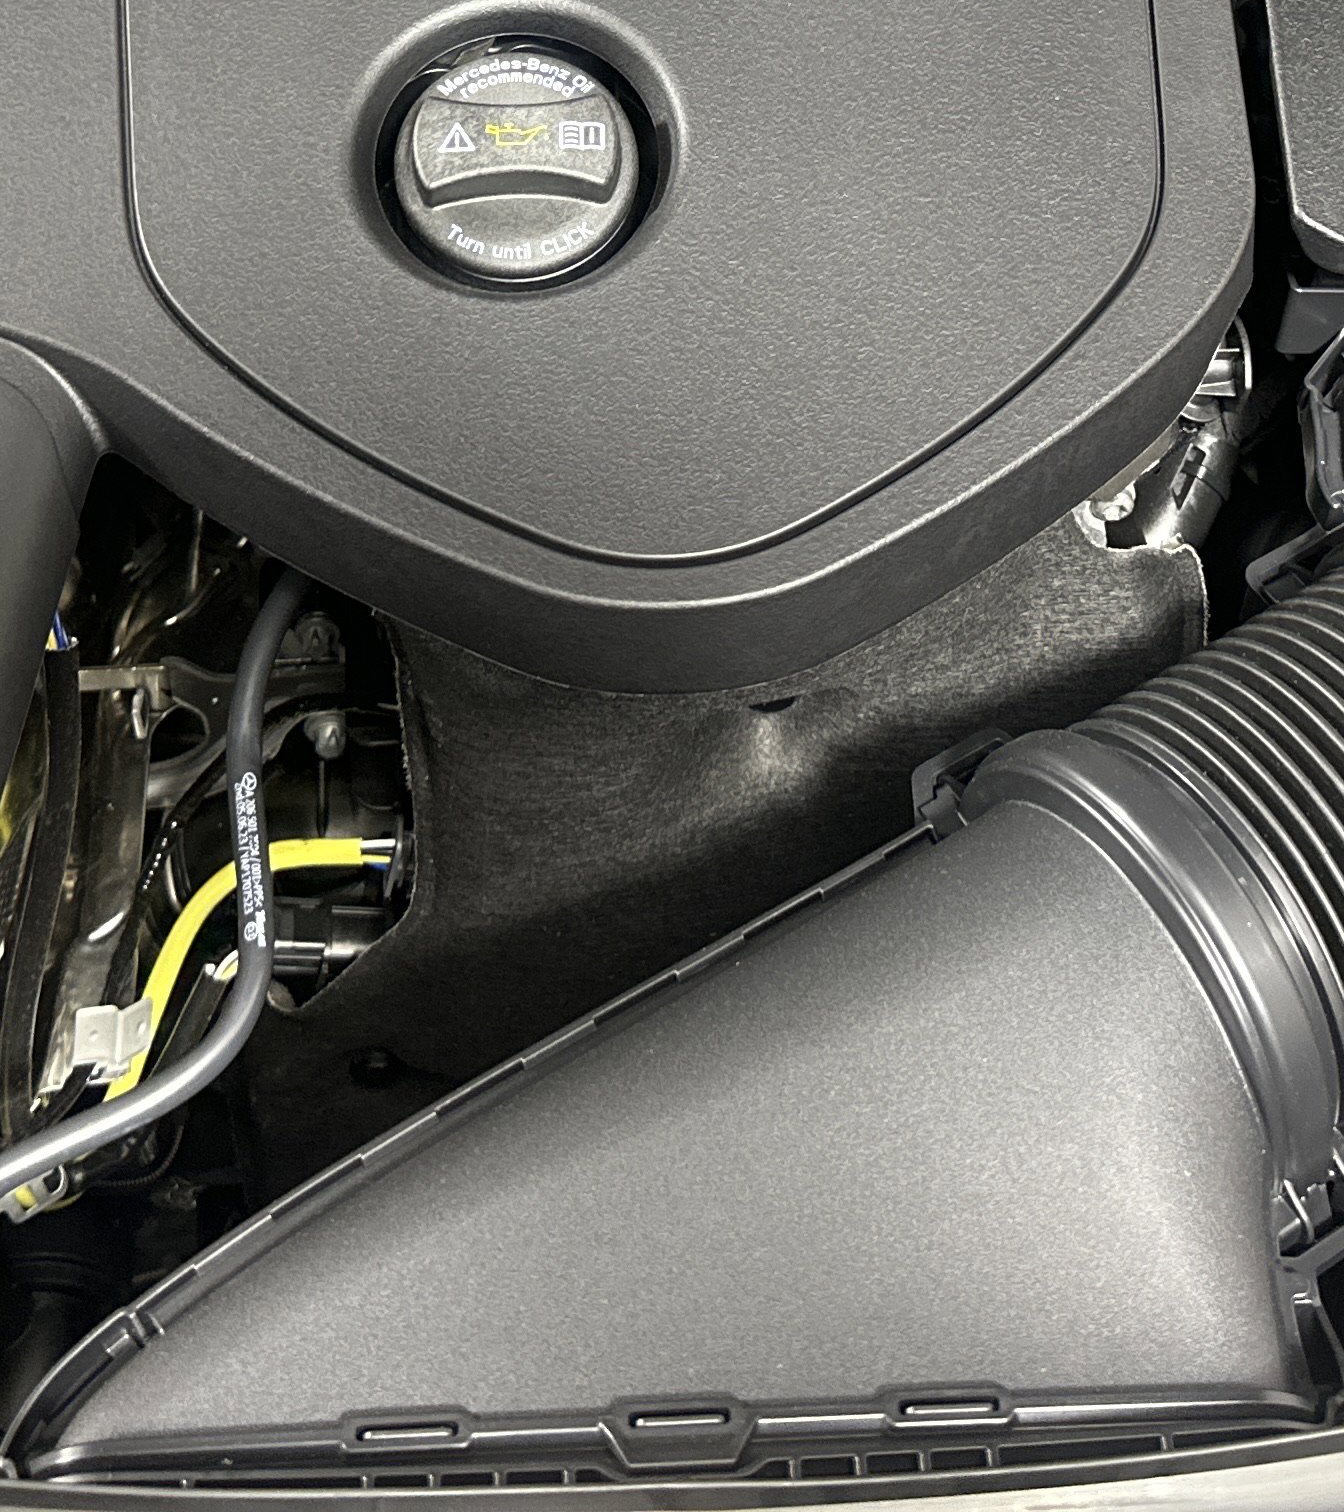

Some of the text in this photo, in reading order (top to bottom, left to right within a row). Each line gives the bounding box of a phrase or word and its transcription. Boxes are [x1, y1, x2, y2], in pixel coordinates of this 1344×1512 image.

[436, 57, 596, 96] Mercedes-Benz Oil
[459, 71, 576, 98] recommended
[447, 221, 595, 260] Turn until CLICK
